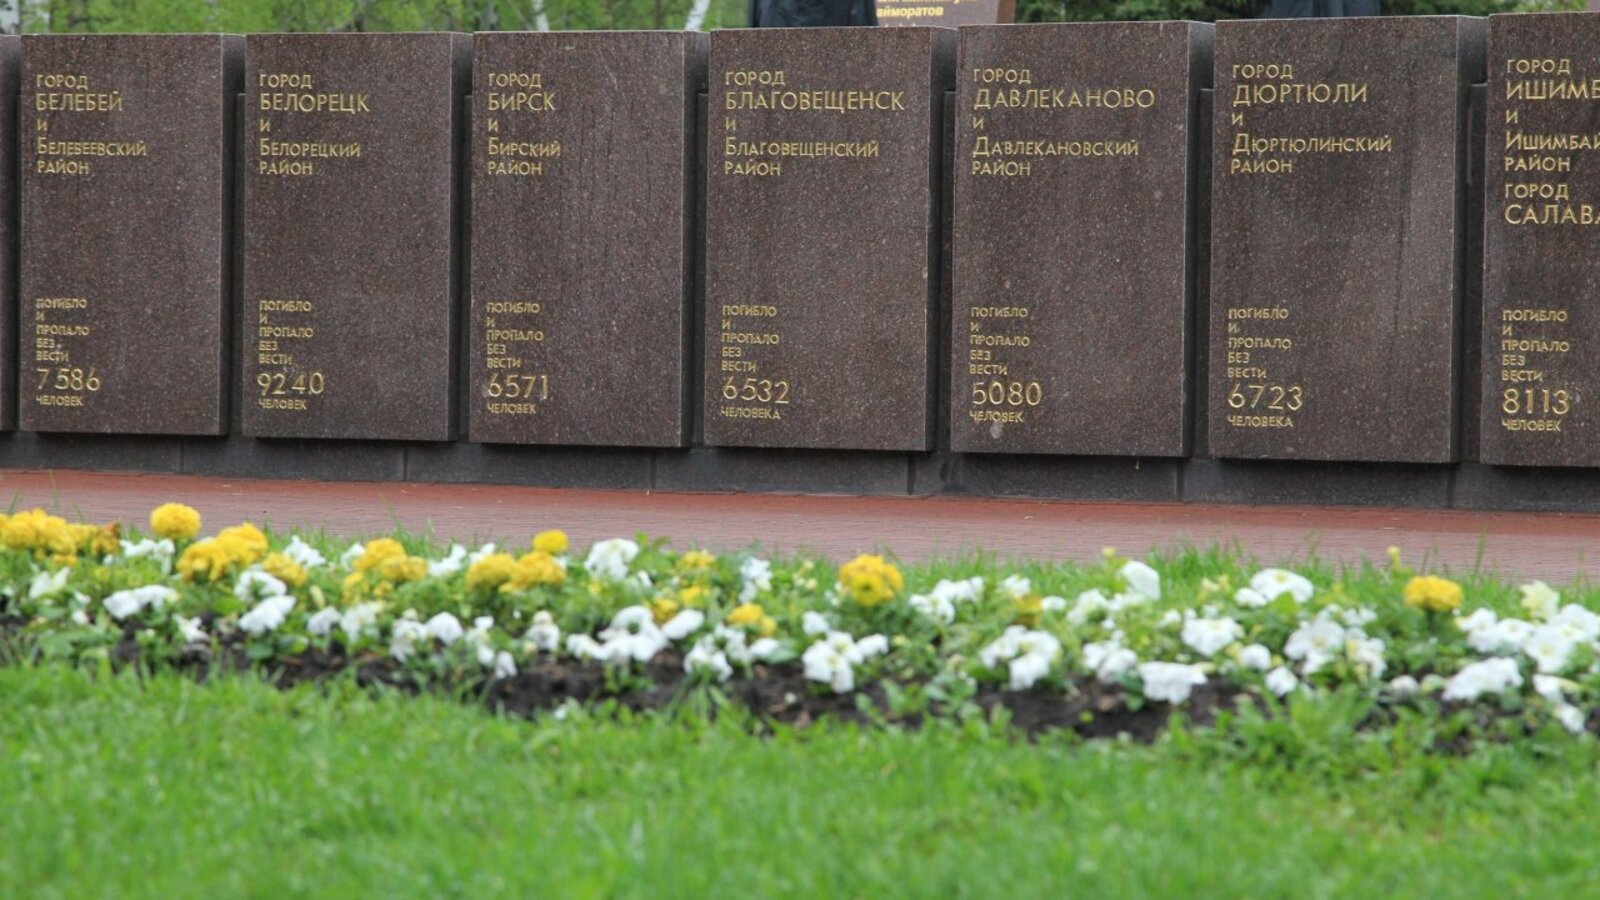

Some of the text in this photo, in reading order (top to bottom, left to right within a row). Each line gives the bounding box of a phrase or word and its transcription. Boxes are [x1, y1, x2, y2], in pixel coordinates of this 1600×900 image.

[1232, 64, 1293, 79] ГОРОД
[1507, 59, 1571, 75] ГОРОД
[36, 74, 88, 90] ГОРОД
[259, 74, 312, 90] ГОРОД
[489, 73, 541, 89] ГОРОД
[725, 70, 785, 87] ГОРОД
[973, 69, 1030, 85] ГОРОД
[35, 91, 123, 111] БЕЛЕБЕЙ
[488, 92, 555, 110] БИРСК
[974, 88, 1155, 110] ДАВЛЕКАНОВО
[1233, 83, 1368, 106] ДЮРТЮЛИ
[259, 93, 370, 113] БЕЛОРЕЦК
[725, 91, 904, 113] БЛАГОВЕЩЕНСК
[973, 116, 983, 129] И
[1232, 113, 1244, 126] И
[1505, 110, 1518, 124] И
[37, 120, 48, 132] И
[259, 120, 270, 132] И
[488, 119, 498, 131] И
[725, 118, 736, 131] И
[37, 137, 147, 156] БЕЛЕБЕЕВСКИЙ
[259, 139, 360, 157] БЕЛОРЕЦКИЙ
[488, 137, 561, 156] БИРСКИЙ
[724, 136, 879, 158] БЛАГОВЕЩЕНСКИЙ
[972, 137, 1139, 158] ДАВЛЕКАНОВСКИЙ
[1232, 133, 1392, 153] ДЮРТЮЛИНСКИЙ
[37, 159, 90, 175] РАЙОН
[259, 160, 312, 175] РАЙОН
[487, 159, 542, 175] РАЙОН
[724, 159, 781, 176] РАЙОН
[972, 160, 1031, 176] РАЙОН
[1231, 158, 1293, 174] РАЙОН
[1505, 154, 1571, 172] РАЙОН
[1505, 183, 1569, 201] ГОРОД
[1504, 204, 1600, 225] САЛАВ
[35, 298, 87, 309] ПОГИБЛО
[259, 300, 311, 312] ПОГИБЛО
[486, 302, 540, 313] ПОГИБЛО
[36, 311, 44, 321] И
[722, 305, 777, 316] ПОГИБЛО
[971, 307, 1029, 318] ПОГИБЛО
[1229, 308, 1289, 319] ПОГИБЛО
[1502, 309, 1568, 322] ПОГИБЛО
[259, 315, 268, 324] И
[486, 317, 495, 327] И
[722, 320, 731, 329] И
[36, 324, 90, 336] ПРОПАЛО
[259, 327, 314, 338] ПРОПАЛО
[971, 322, 980, 332] И
[1229, 323, 1239, 332] И
[1502, 325, 1512, 336] И
[486, 330, 544, 341] ПРОПАЛО
[721, 333, 779, 345] ПРОПАЛО
[970, 334, 1030, 347] ПРОПАЛО
[36, 338, 55, 348] БЕЗ
[259, 340, 278, 351] БЕЗ
[486, 344, 506, 355] БЕЗ
[1229, 336, 1292, 350] ПРОПАЛО
[1502, 339, 1570, 352] ПРОПАЛО
[36, 350, 69, 362] ВЕСТИ
[259, 353, 292, 364] ВЕСТИ
[721, 347, 741, 357] БЕЗ
[970, 350, 991, 360] БЕЗ
[1228, 352, 1250, 363] БЕЗ
[486, 357, 520, 369] ВЕСТИ
[721, 360, 756, 372] ВЕСТИ
[1502, 354, 1525, 366] БЕЗ
[970, 363, 1007, 375] ВЕСТИ
[1228, 366, 1266, 378] ВЕСТИ
[1502, 369, 1542, 382] ВЕСТИ
[36, 368, 100, 391] 7586
[257, 372, 325, 395] 9240
[487, 374, 549, 399] 6571
[722, 378, 790, 404] 6532
[972, 381, 1043, 406] 5080
[1227, 384, 1304, 411] 6723
[35, 395, 83, 406] ЧЕЛОВЕК
[259, 399, 306, 410] ЧЕЛОВЕК
[1503, 388, 1569, 415] 8113
[486, 403, 536, 414] ЧЕЛОВЕК
[720, 407, 780, 420] ЧЕЛОВЕКА
[969, 410, 1023, 422] ЧЕЛОВЕК
[1227, 415, 1293, 427] ЧЕЛОВЕКА
[1502, 419, 1562, 432] ЧЕЛОВЕК
